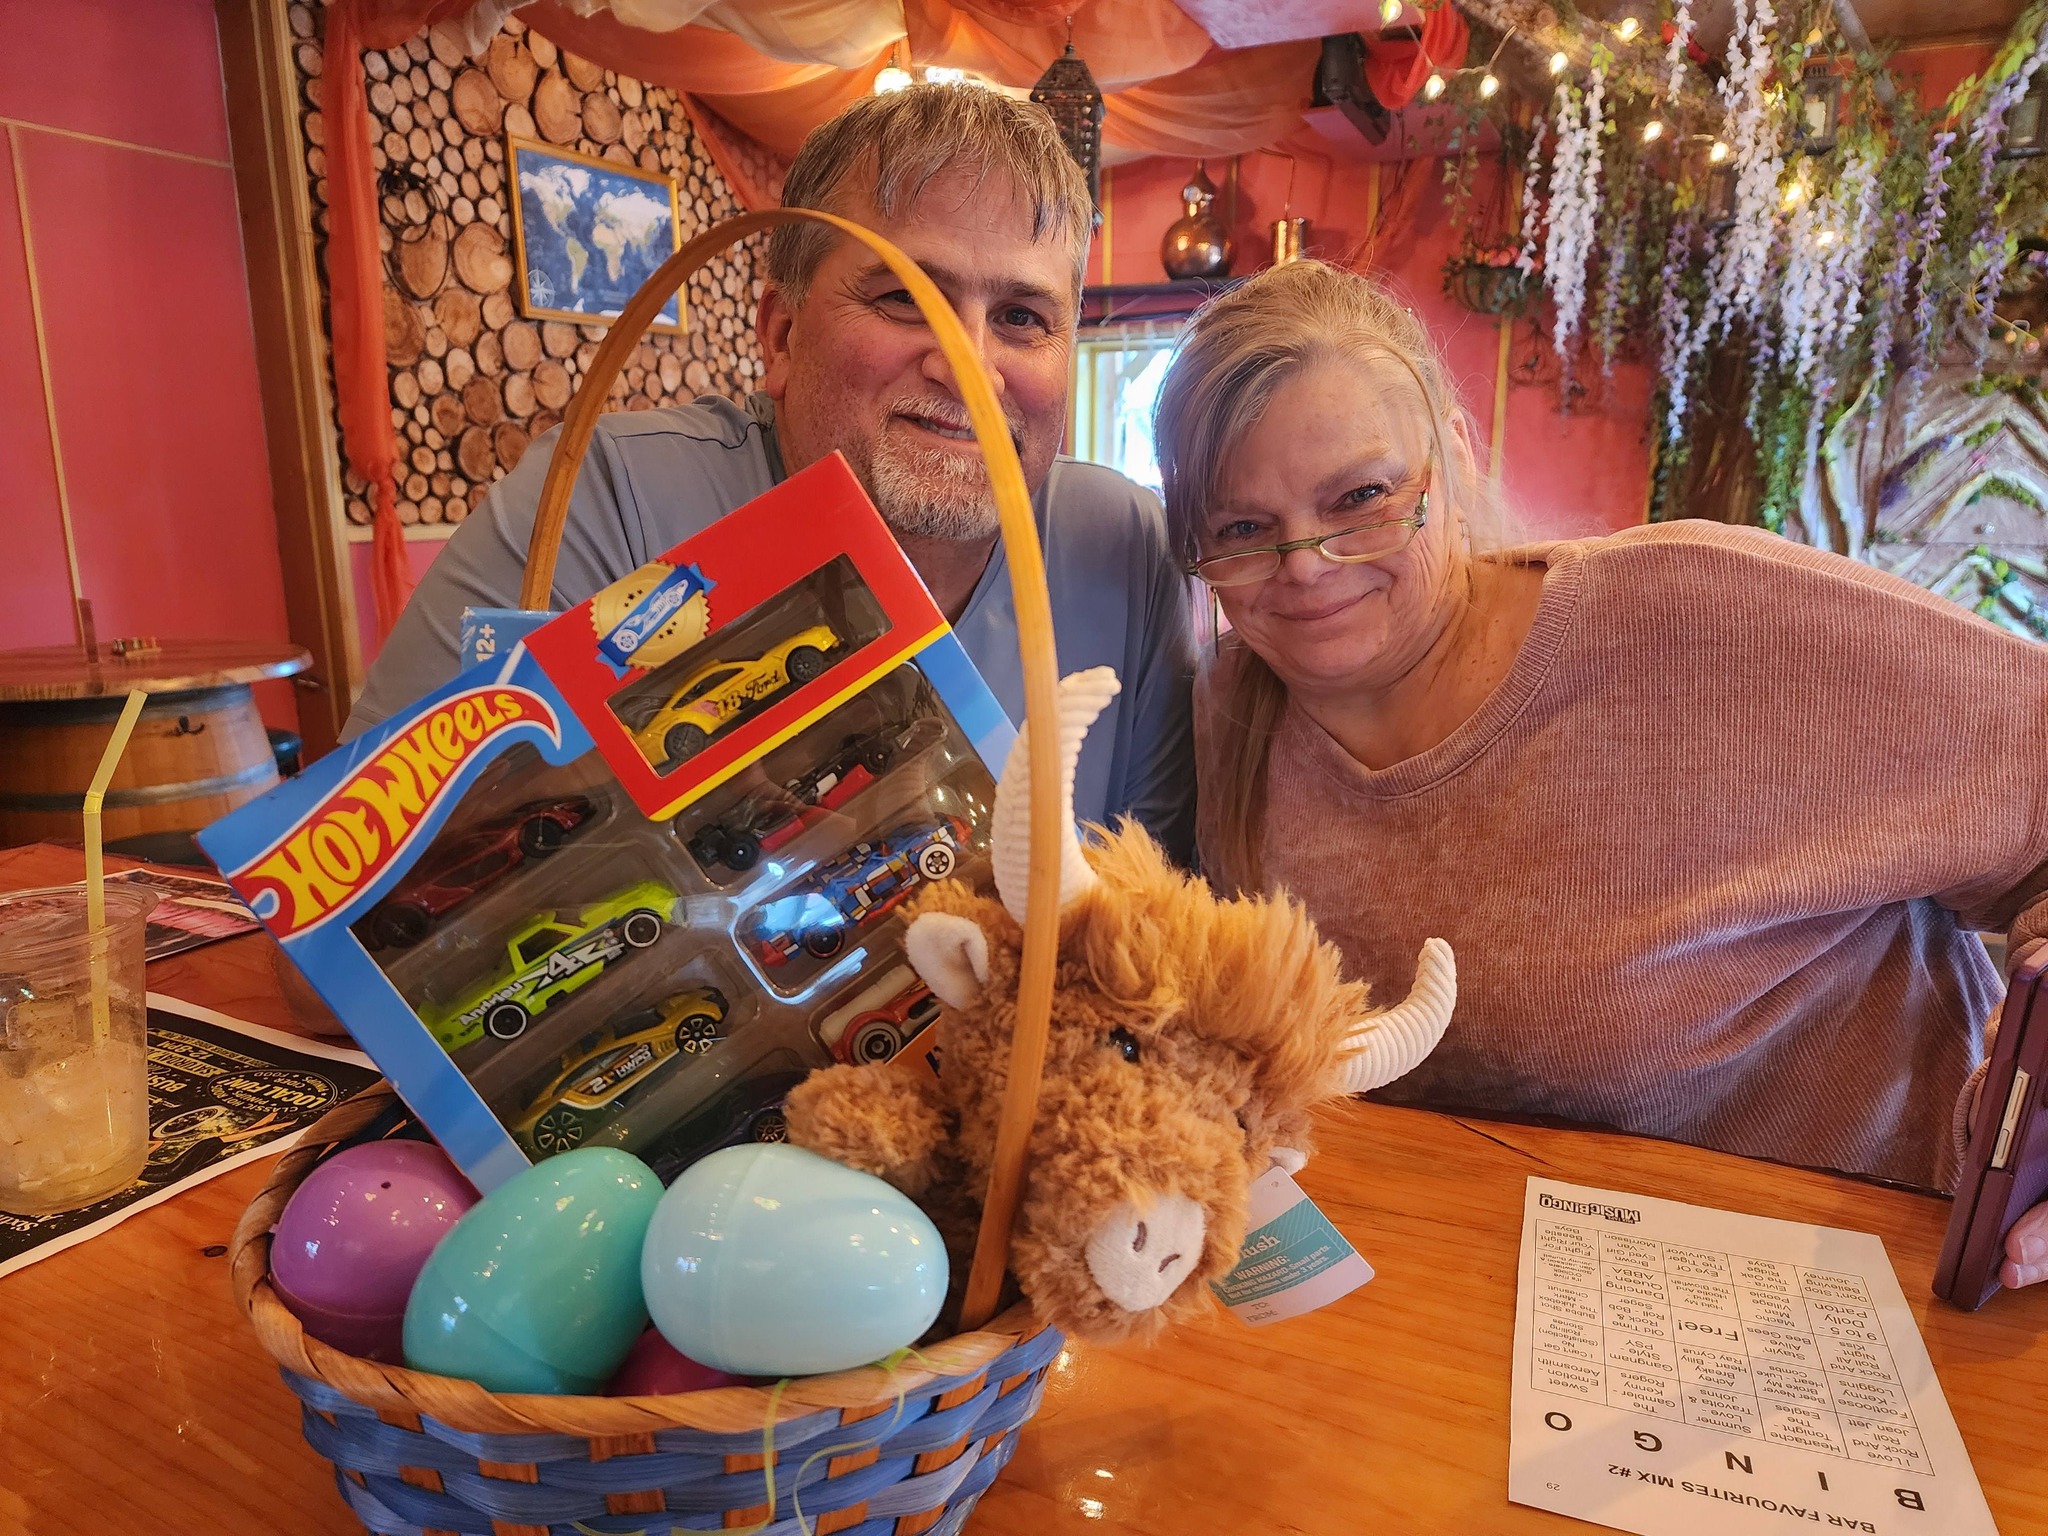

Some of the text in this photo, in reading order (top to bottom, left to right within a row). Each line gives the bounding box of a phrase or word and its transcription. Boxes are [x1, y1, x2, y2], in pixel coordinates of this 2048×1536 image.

[475, 623, 496, 662] 12+
[746, 670, 782, 701] Ford
[263, 1086, 327, 1109] LOCAL
[242, 1103, 298, 1113] CLASSIC
[1240, 1234, 1281, 1259] lush
[1233, 1255, 1291, 1280] WARNING:
[1549, 1323, 1580, 1335] Rolling
[1543, 1342, 1559, 1350] Get
[1561, 1339, 1574, 1347] No
[1624, 1338, 1653, 1350] PSY
[1609, 1351, 1672, 1372] Gangnam
[1628, 1346, 1660, 1360] Style
[1681, 1346, 1742, 1365] Ray Cyrus
[1537, 1357, 1600, 1377] Aerosmith
[1679, 1353, 1747, 1373] Heart Billy
[1767, 1364, 1807, 1378] Combs
[1547, 1368, 1598, 1386] Emotion
[1548, 1377, 1588, 1393] Sweet
[1620, 1370, 1664, 1387] Rogers
[1755, 1369, 1824, 1388] Heart Luke
[1623, 1379, 1663, 1395] Kenny
[1699, 1388, 1738, 1403] Johns
[1761, 1385, 1826, 1404] Beer Never
[1764, 1378, 1818, 1395] Broke My
[1837, 1378, 1894, 1397] Loggins
[1621, 1389, 1675, 1408] Gambler
[1840, 1388, 1888, 1405] Kenny
[1632, 1401, 1657, 1413] The
[1701, 1397, 1753, 1415] Travolta
[1773, 1402, 1820, 1419] Eagles
[1836, 1397, 1908, 1419] Footloose
[1695, 1414, 1752, 1433] Summer
[1710, 1409, 1742, 1422] Love
[1786, 1415, 1813, 1427] The
[1781, 1422, 1832, 1441] Tonight
[1846, 1418, 1911, 1437] Joan Jett
[1769, 1430, 1841, 1452] Heartache
[1872, 1432, 1900, 1445] Roll
[1851, 1438, 1919, 1458] Rock And
[1866, 1450, 1902, 1464] Love
[1544, 1411, 1926, 1512] B I N G O
[1546, 1481, 1561, 1491] 29
[1608, 1464, 1876, 1534] BAR FAVOURITES MIX #2
